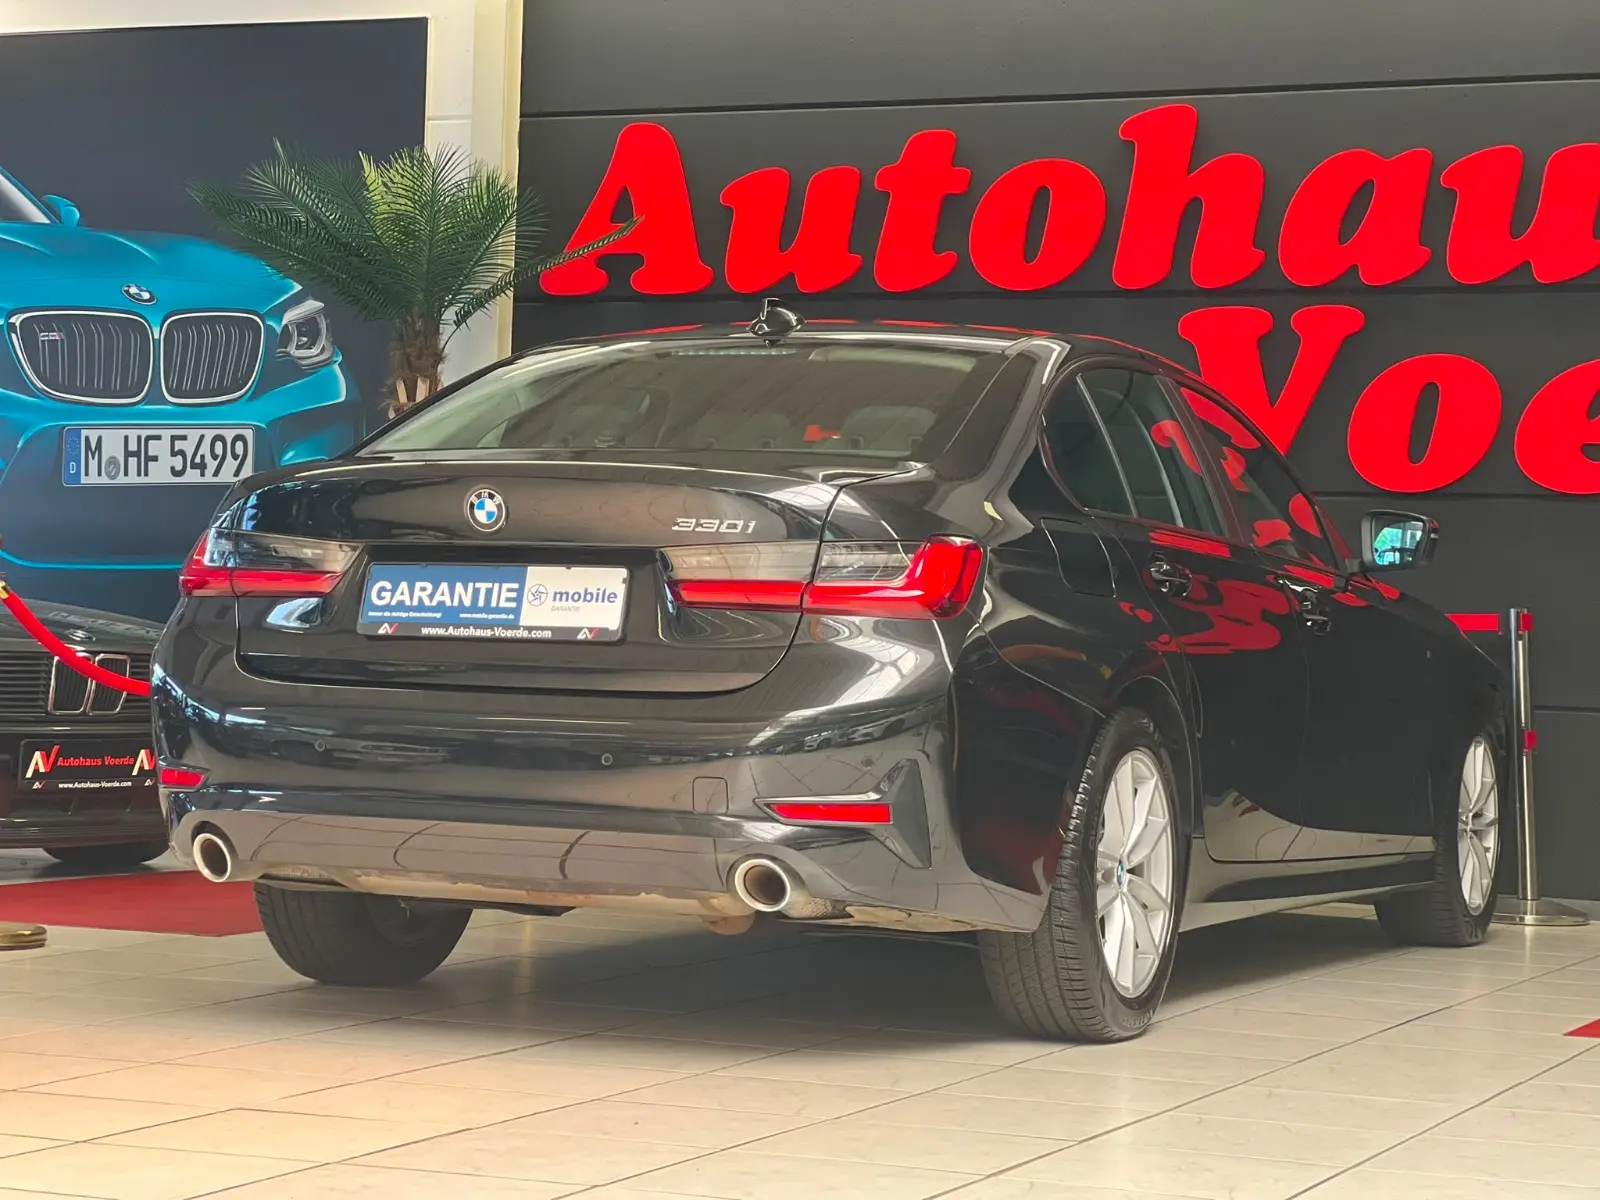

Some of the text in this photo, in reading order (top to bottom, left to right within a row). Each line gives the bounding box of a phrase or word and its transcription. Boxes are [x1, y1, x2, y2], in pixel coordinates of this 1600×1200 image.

[540, 103, 1600, 296] Autohau
[84, 433, 249, 478] M HF 5499
[671, 517, 756, 534] 330i
[370, 580, 519, 608] GARANTIE
[552, 587, 618, 604] mobile
[421, 625, 552, 638] www.Autohaus-Voerde.com
[57, 755, 135, 767] Autohaus Voerde
[58, 780, 132, 789] www.Autohaus-Voerde.com
